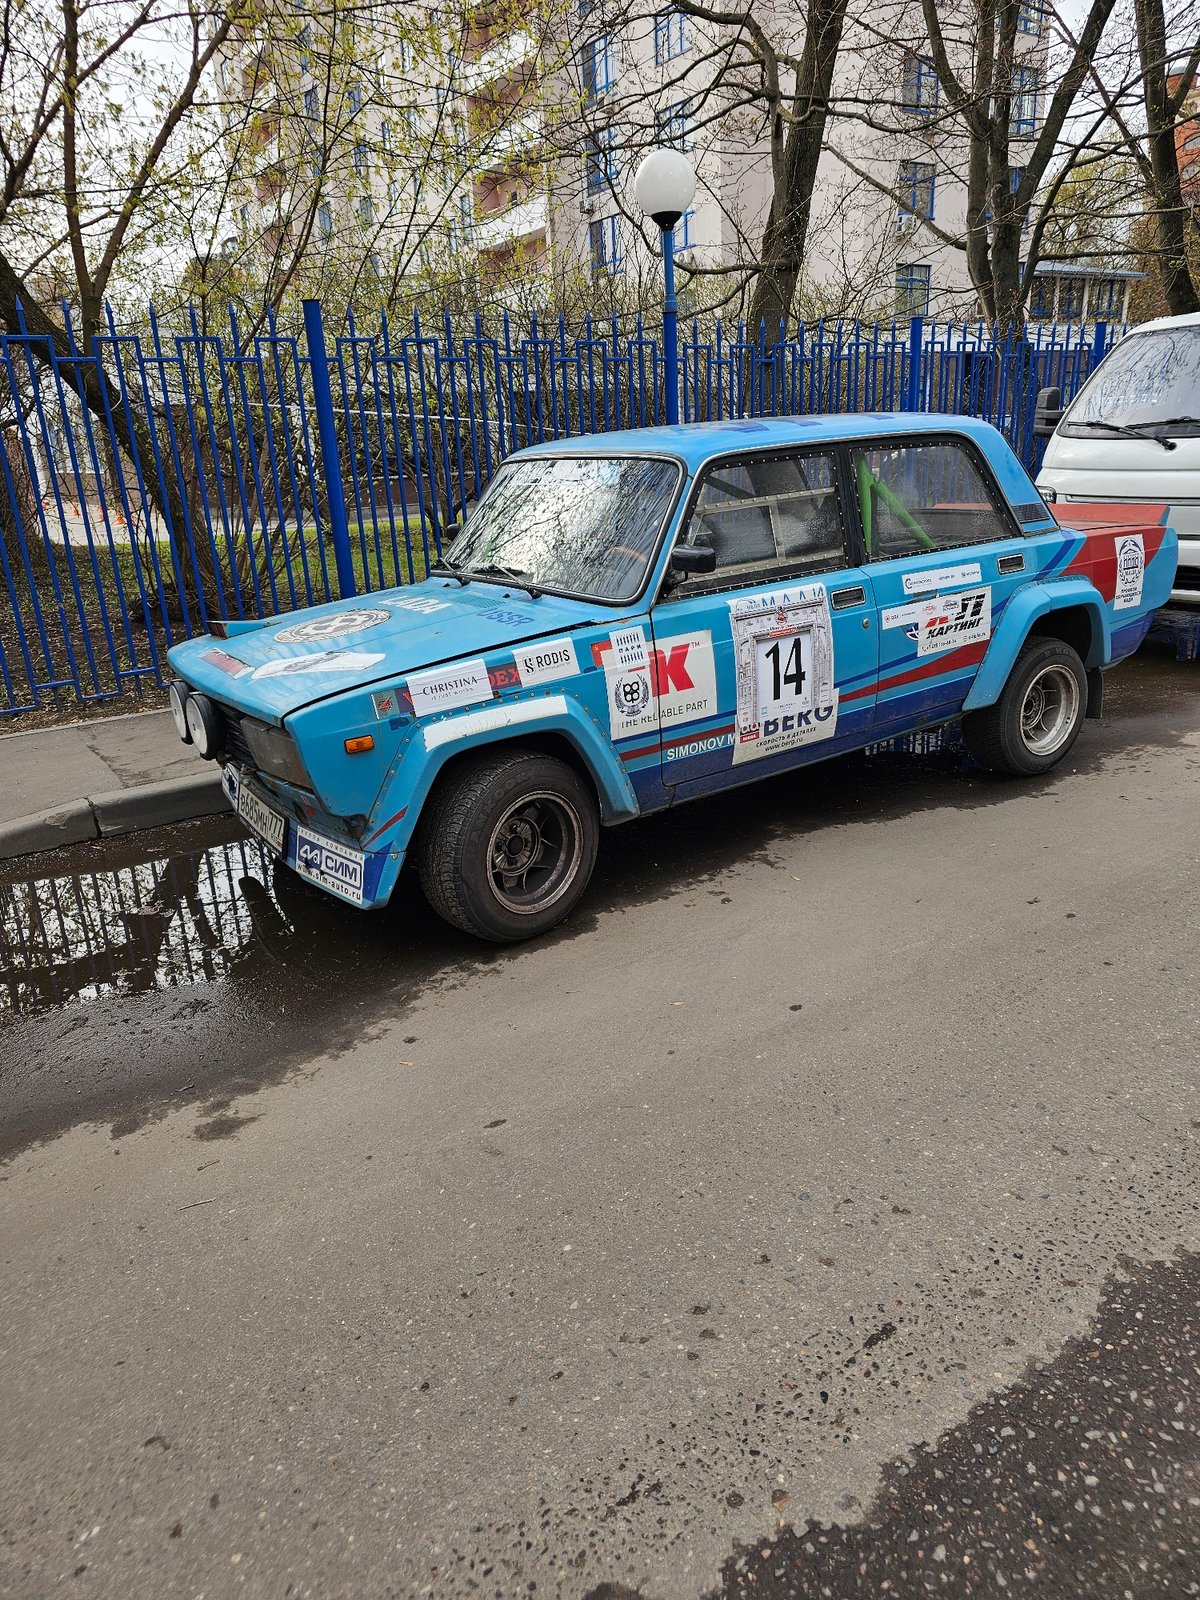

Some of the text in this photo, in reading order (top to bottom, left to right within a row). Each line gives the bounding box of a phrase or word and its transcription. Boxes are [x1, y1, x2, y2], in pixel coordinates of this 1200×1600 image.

[475, 608, 536, 628] USSR
[926, 617, 984, 640] КАРТИНГ
[537, 649, 572, 668] RODIS
[764, 637, 807, 701] 14
[422, 675, 478, 696] CHRISTINA
[685, 699, 709, 713] PART
[755, 735, 786, 748] СКОРОСТЬ
[791, 726, 817, 739] ДЕТАЛЯХ
[764, 737, 804, 752] www.berg.ru
[667, 735, 725, 761] SIMONOV
[325, 854, 358, 883] СИМ
